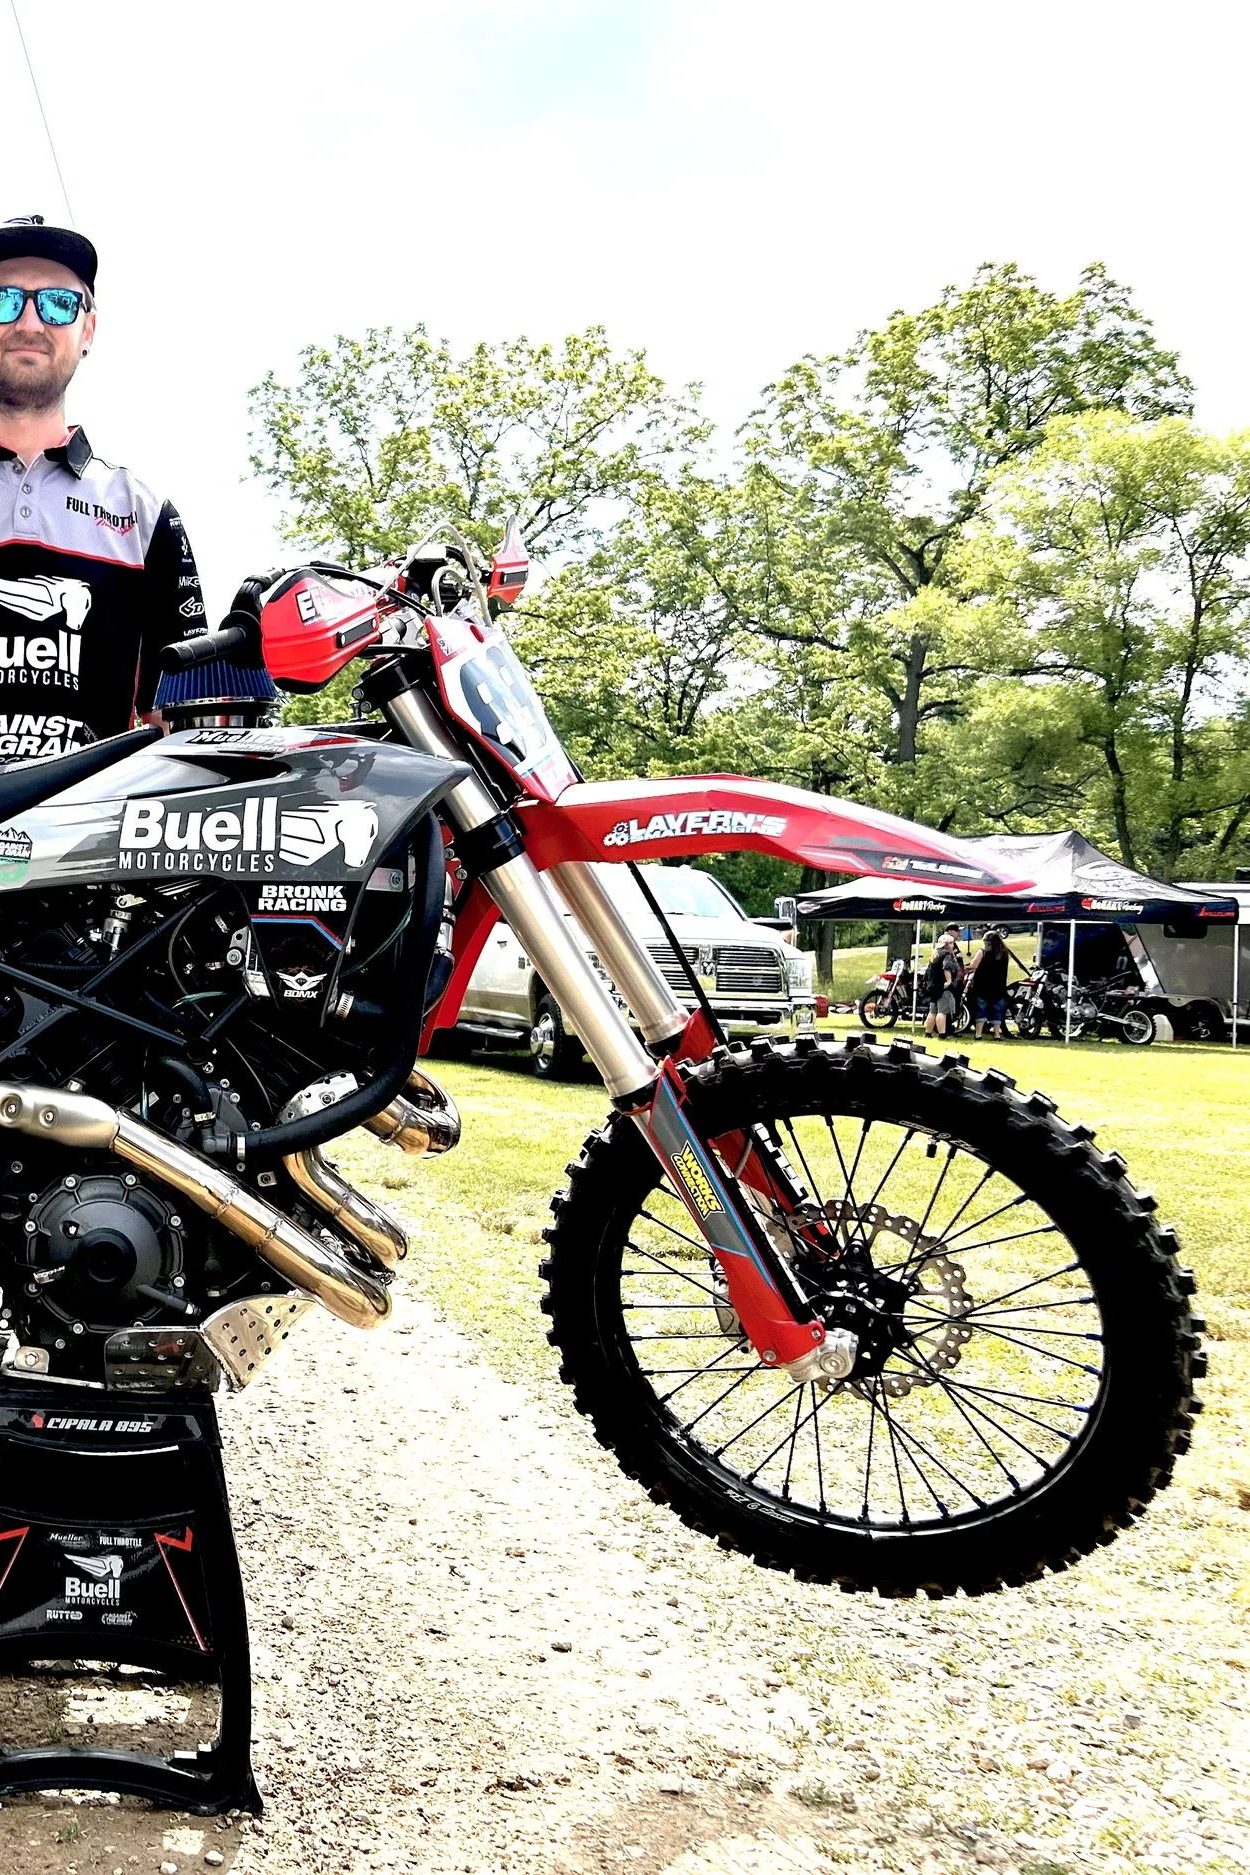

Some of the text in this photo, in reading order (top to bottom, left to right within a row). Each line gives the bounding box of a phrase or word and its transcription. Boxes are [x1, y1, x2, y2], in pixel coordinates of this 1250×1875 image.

[66, 496, 138, 529] FULL THROTTL
[119, 796, 278, 851] Buell
[629, 810, 787, 837] LAVERN'S
[119, 851, 275, 873] MOTORCYCLES
[262, 884, 345, 899] BRONK
[258, 897, 347, 912] RACING
[673, 1154, 710, 1217] CONNECTION
[682, 1144, 724, 1212] WORKS
[46, 1416, 154, 1434] CIPALA 895
[50, 1532, 82, 1541] Mueller
[99, 1536, 113, 1545] FULL
[113, 1536, 143, 1547] THROTTLE
[65, 1576, 121, 1599] Buell
[65, 1596, 120, 1606] MOTORCYCLES
